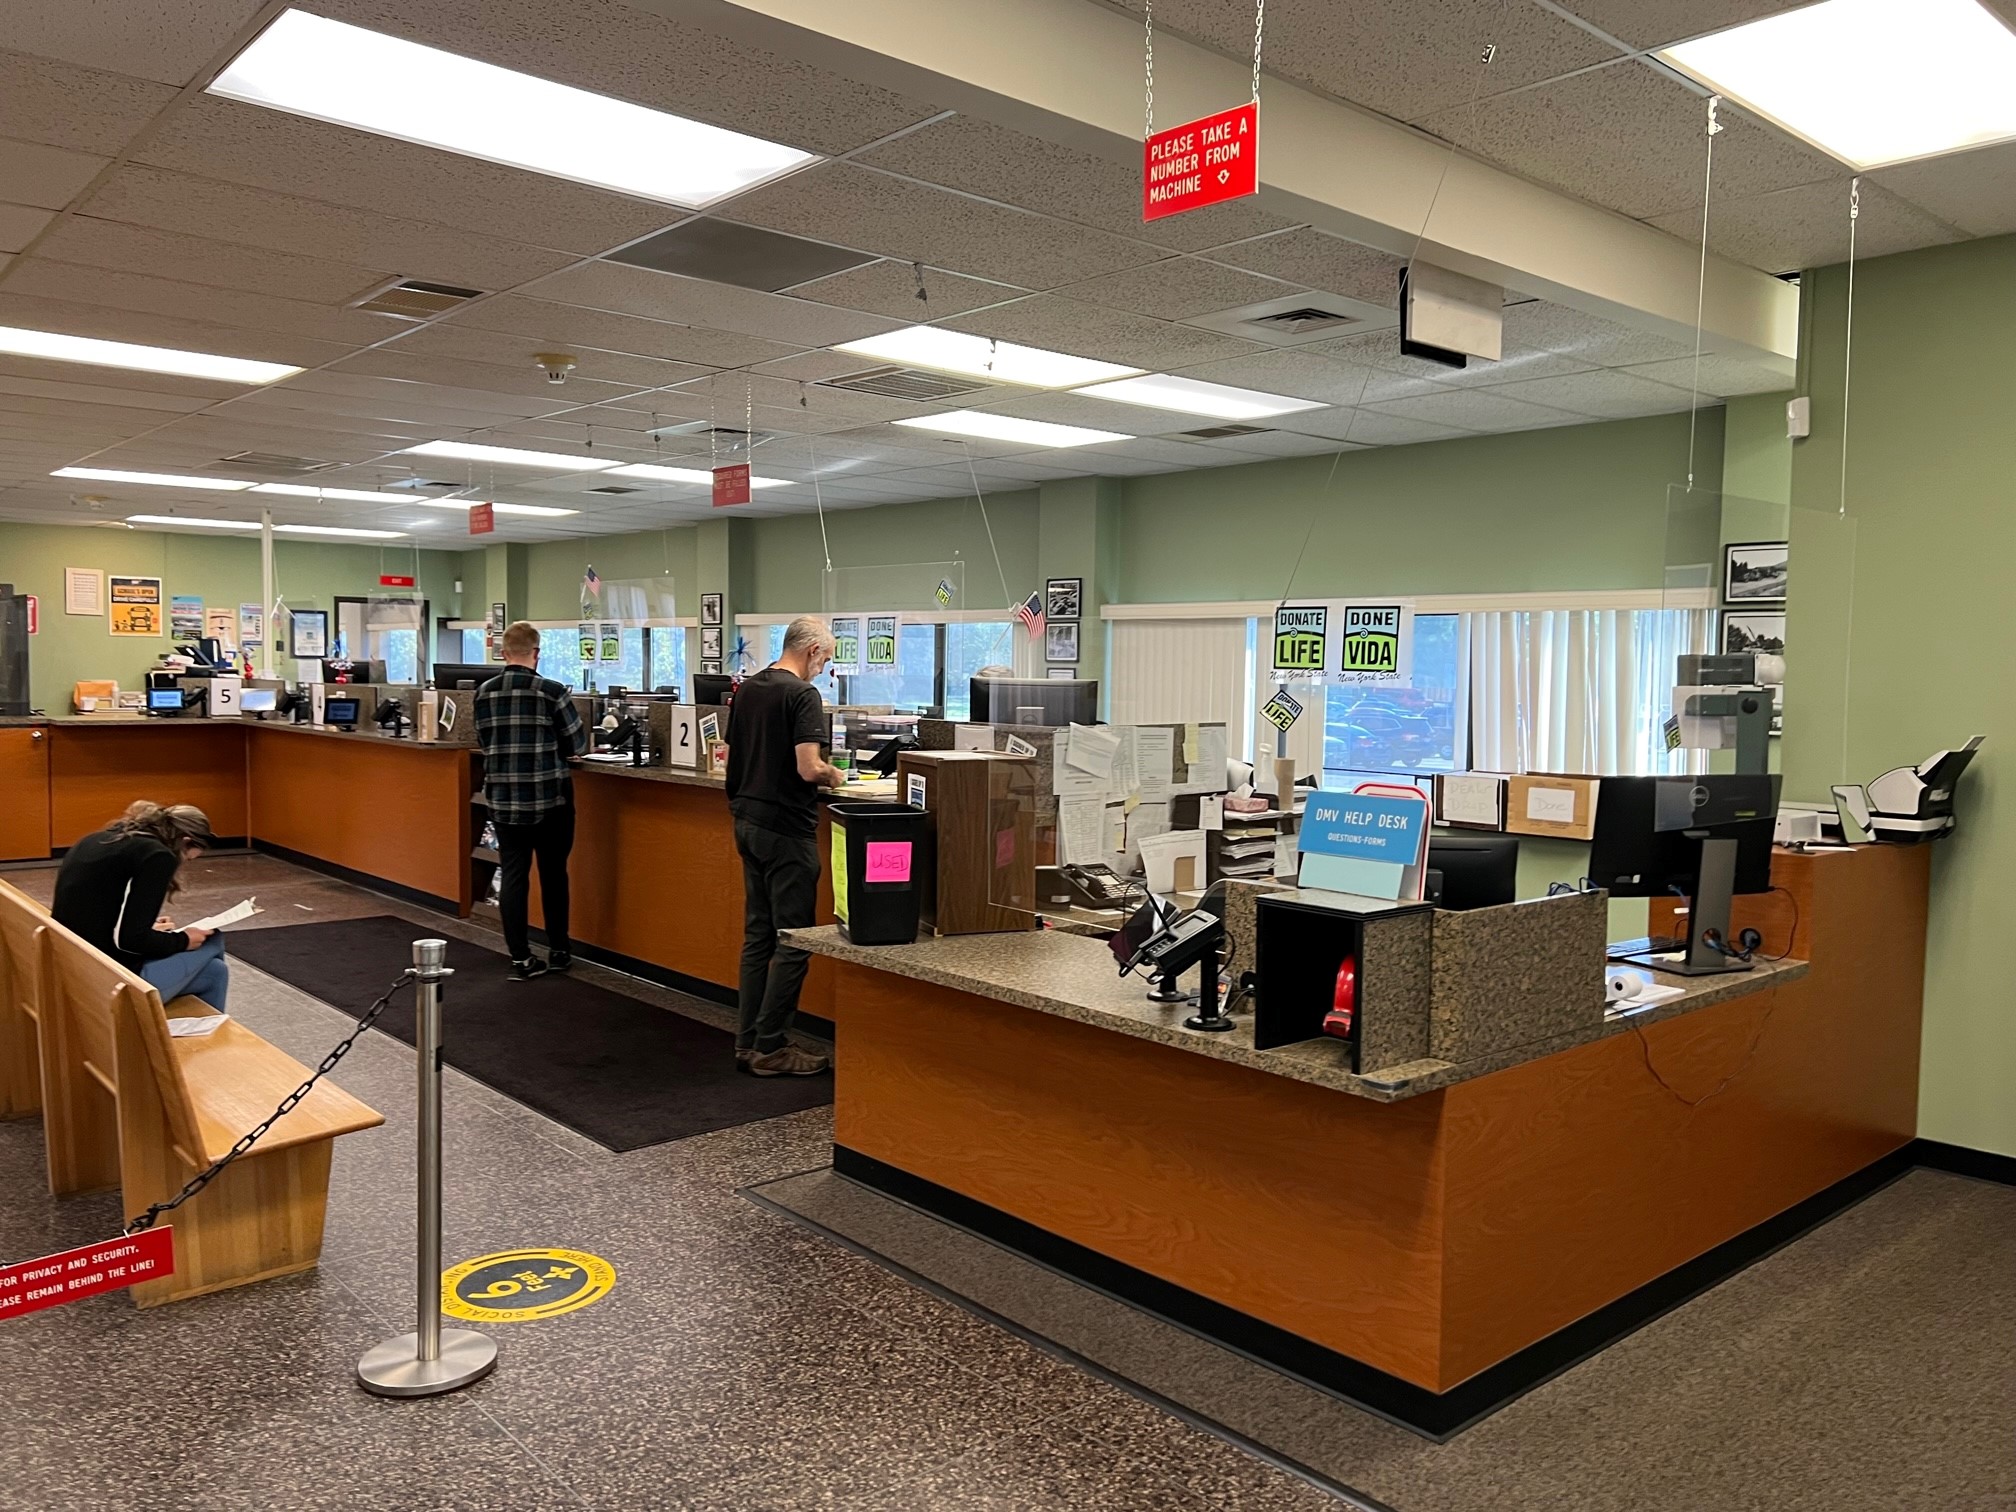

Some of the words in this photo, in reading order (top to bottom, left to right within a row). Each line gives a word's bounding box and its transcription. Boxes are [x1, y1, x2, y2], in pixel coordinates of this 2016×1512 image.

[1151, 133, 1194, 161] PLEASE
[1201, 121, 1232, 146] TAKE
[1239, 117, 1248, 135] A
[1150, 154, 1199, 183] NUMBER
[1205, 141, 1240, 167] FROM
[1150, 174, 1201, 204] MACHINE
[870, 621, 892, 631] DONE
[1280, 612, 1323, 626] DONATE
[1350, 612, 1394, 626] DONE
[835, 642, 856, 660] LIFE
[870, 642, 892, 660] VIDA
[1279, 640, 1321, 664] LIFE
[1348, 641, 1392, 666] VIDA
[1270, 671, 1285, 680] New
[1287, 670, 1307, 681] York
[1308, 668, 1328, 678] State
[1338, 673, 1355, 683] New
[1357, 671, 1377, 684] York
[1378, 670, 1401, 681] State
[221, 688, 231, 703] 5
[1264, 703, 1292, 729] LIFE
[680, 722, 689, 747] 2
[1315, 808, 1339, 822] DMV
[1344, 811, 1373, 826] HELP
[1378, 814, 1409, 830] DESK
[1327, 832, 1387, 847] QUESTIONS-FORMS
[872, 854, 909, 872] USED
[22, 1264, 63, 1282] PRIVACY
[67, 1258, 87, 1270] AND
[92, 1245, 140, 1264] SECURITY.
[26, 1284, 63, 1301] REMAIN
[69, 1273, 103, 1290] BEHIND
[108, 1267, 126, 1279] THE
[467, 1280, 523, 1299] 6
[511, 1270, 553, 1292] Feet
[463, 1307, 526, 1319] SOCIAL
